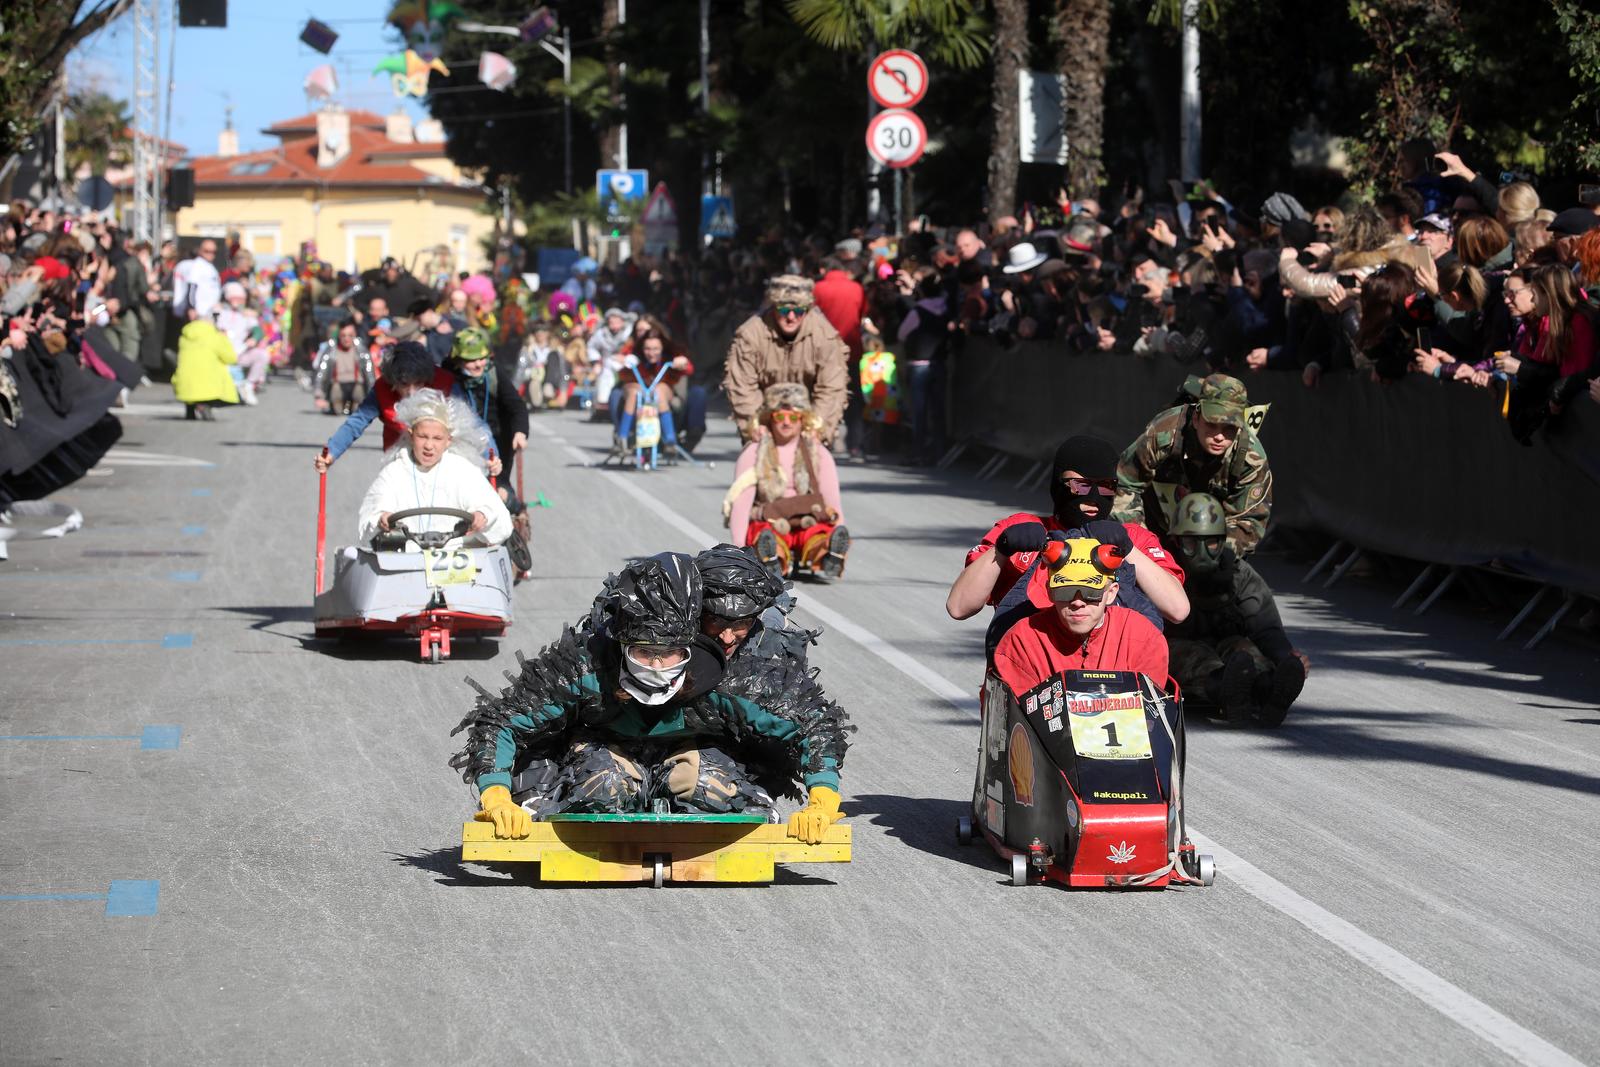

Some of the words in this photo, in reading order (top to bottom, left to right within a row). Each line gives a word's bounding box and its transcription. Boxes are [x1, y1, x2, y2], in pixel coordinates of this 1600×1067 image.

[882, 127, 912, 149] 30
[431, 549, 469, 571] 25
[1069, 696, 1143, 713] BALINJERADA
[1101, 722, 1123, 747] 1
